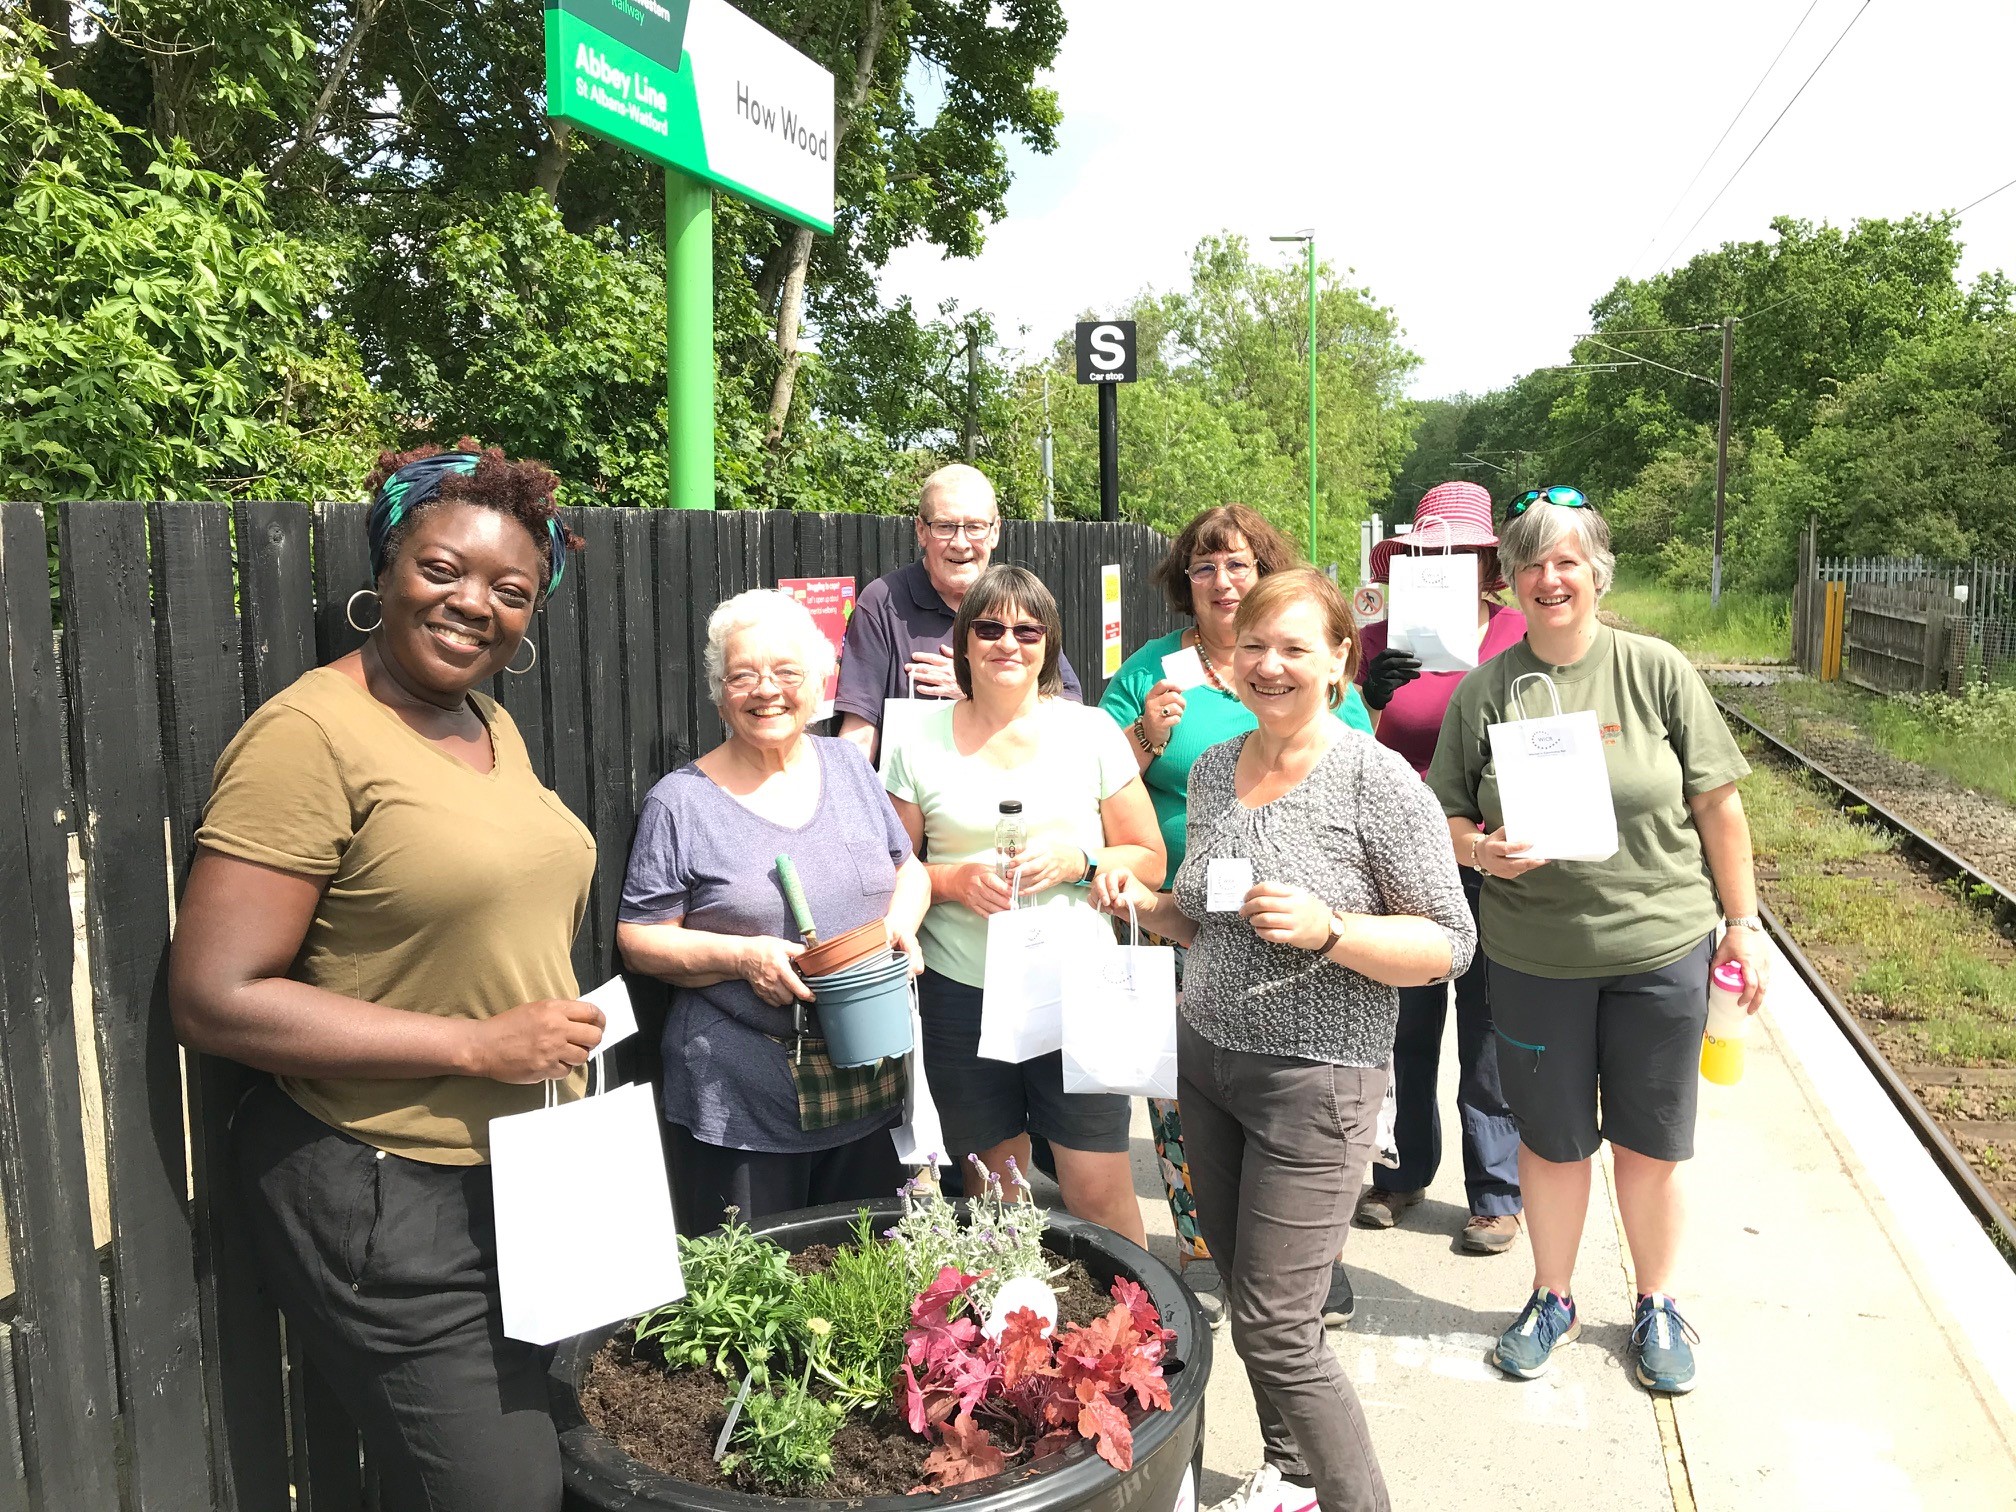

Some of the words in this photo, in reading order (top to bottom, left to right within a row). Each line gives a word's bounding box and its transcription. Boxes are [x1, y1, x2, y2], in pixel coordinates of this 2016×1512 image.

[575, 42, 631, 99] Abbey
[634, 72, 668, 113] Line
[576, 76, 588, 99] St
[590, 84, 669, 137] Albans-Watford
[737, 80, 776, 133] How
[781, 106, 827, 162] Wood
[1089, 372, 1104, 381] Car
[1105, 372, 1125, 381] stop
[1090, 324, 1126, 370] S
